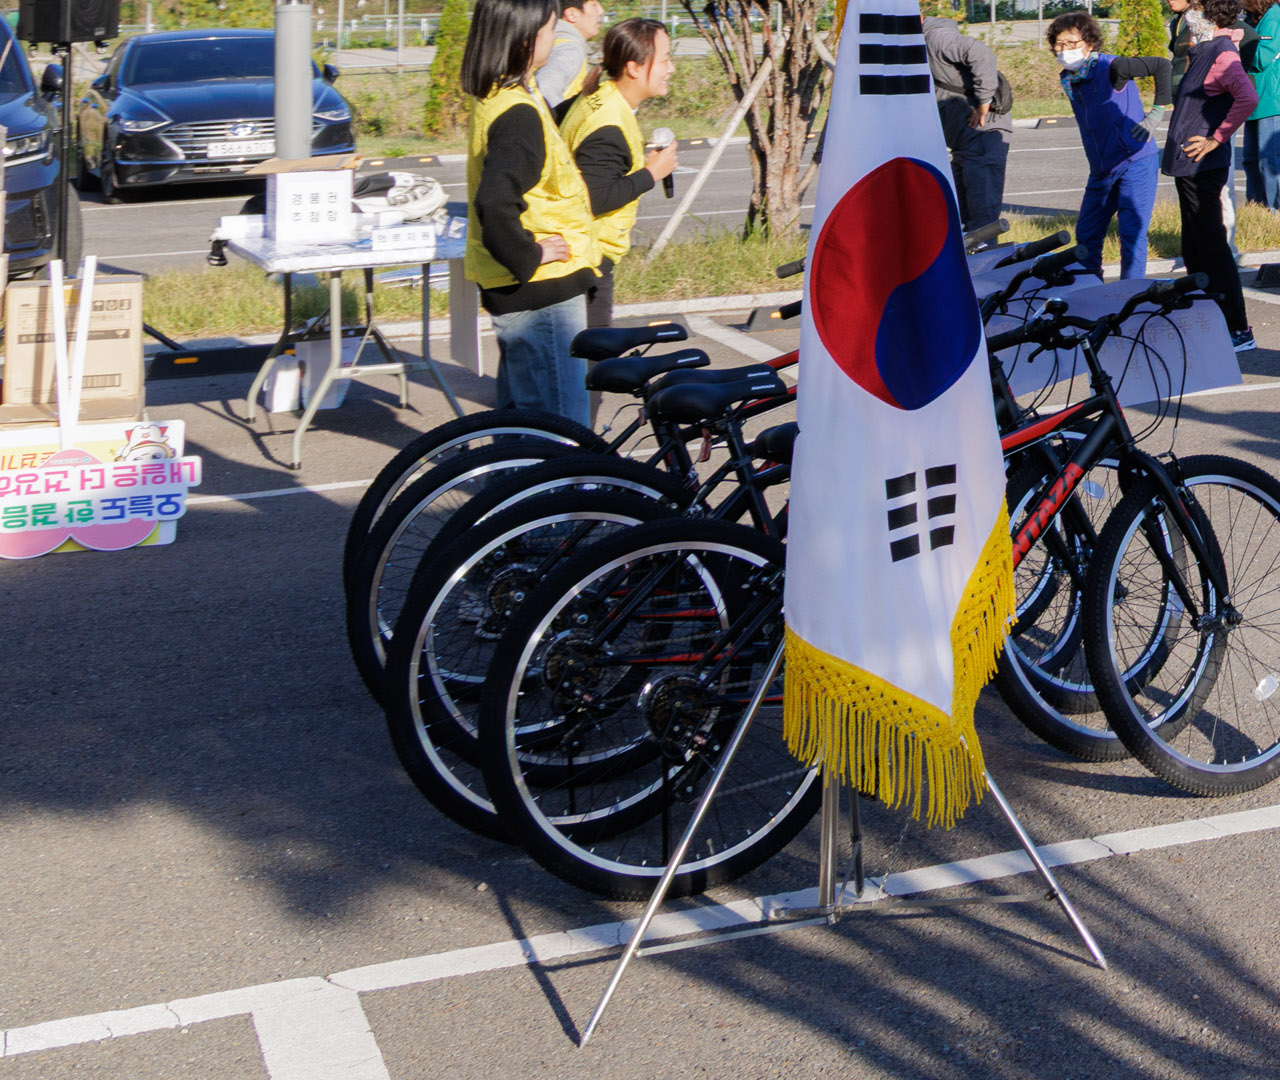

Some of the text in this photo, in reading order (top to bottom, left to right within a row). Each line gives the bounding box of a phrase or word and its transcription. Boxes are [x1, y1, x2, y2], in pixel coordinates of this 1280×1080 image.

[80, 468, 105, 491] 더
[112, 461, 196, 488] 내일은
[0, 492, 183, 529] 오늘도 한 걸음
